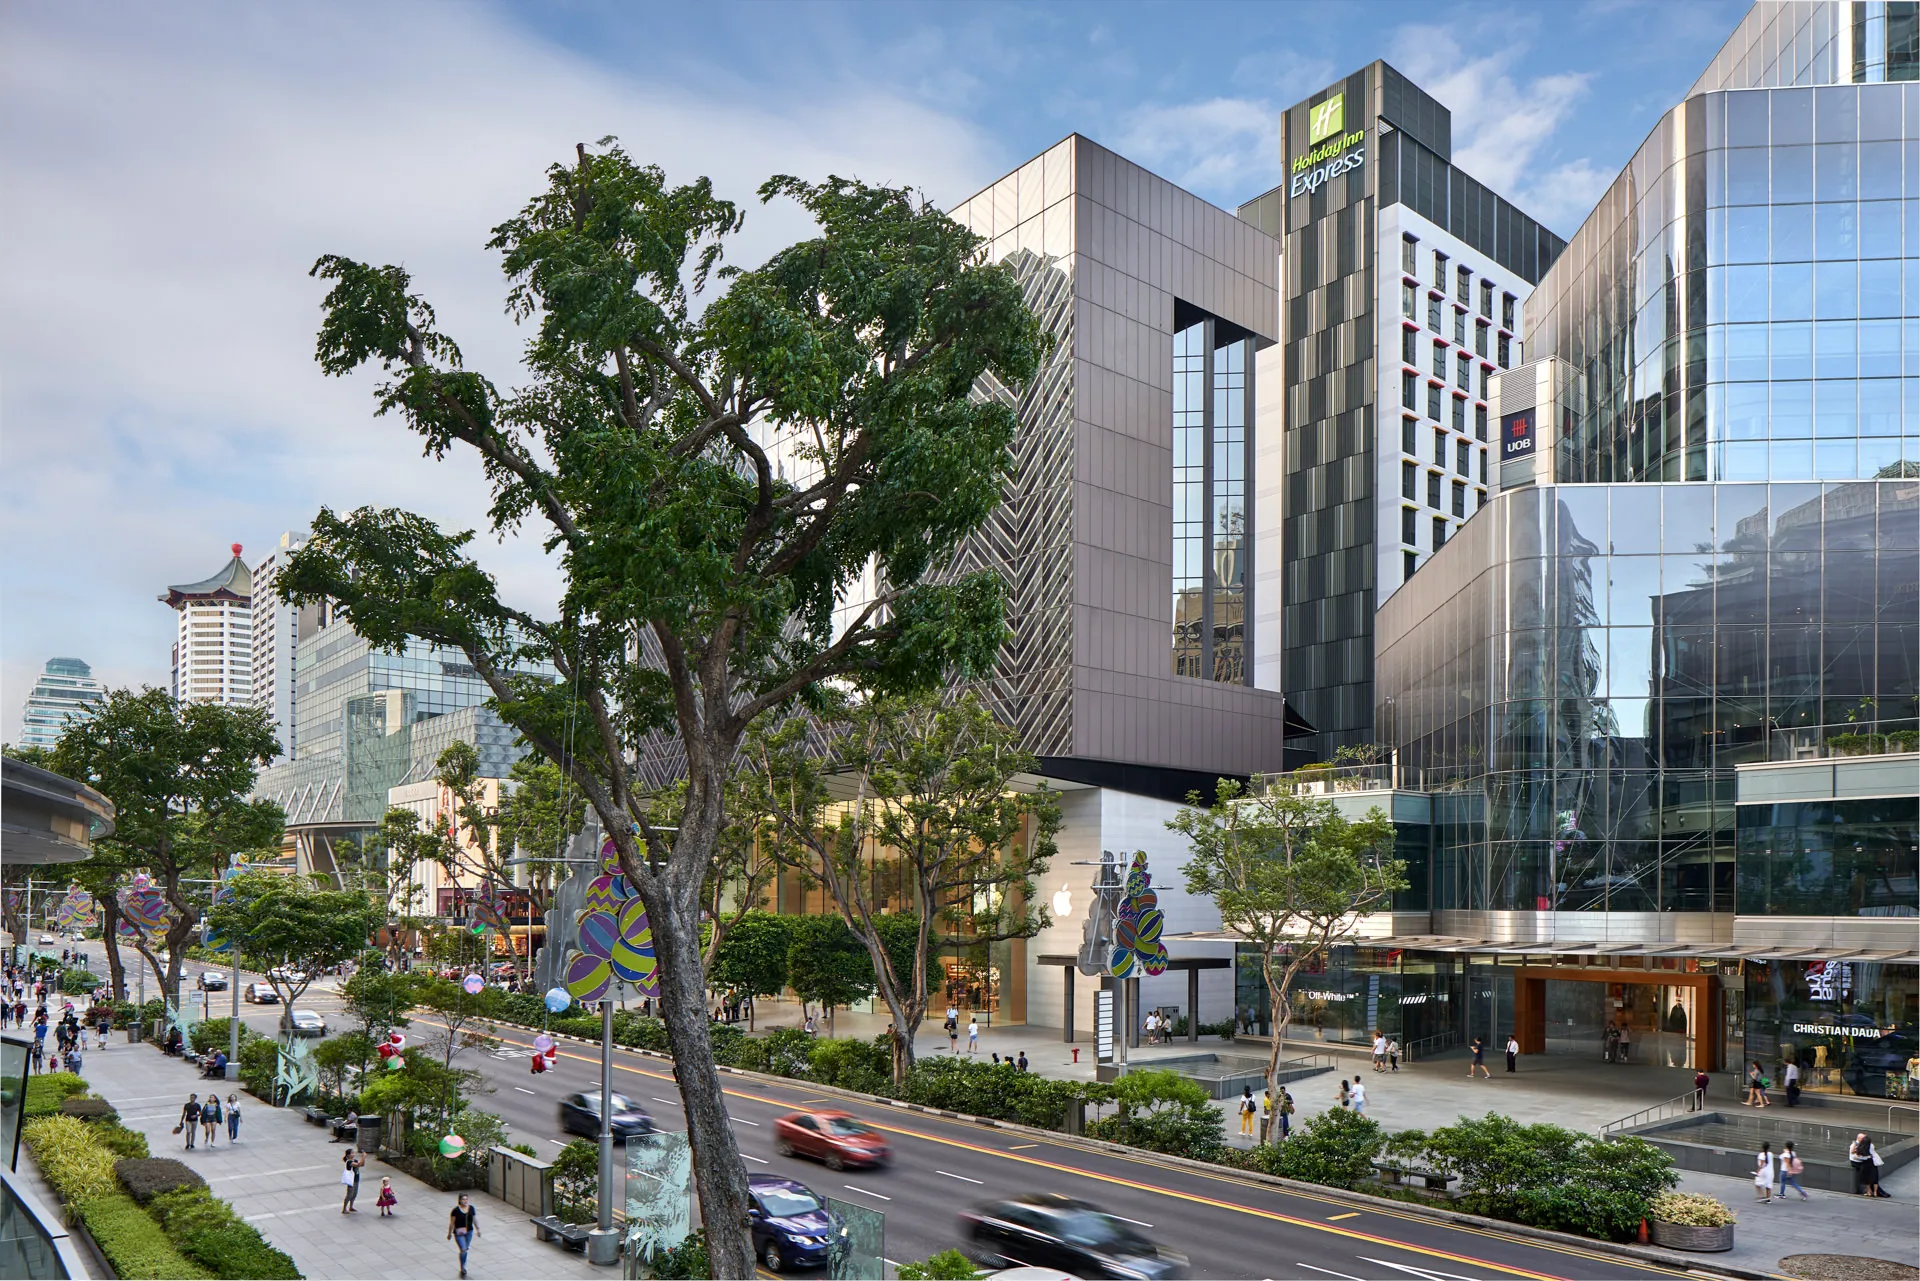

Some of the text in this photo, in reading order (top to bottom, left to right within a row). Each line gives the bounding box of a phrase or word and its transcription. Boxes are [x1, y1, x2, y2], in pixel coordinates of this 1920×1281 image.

[1292, 129, 1364, 174] Holiday Inn
[1290, 148, 1365, 199] Express
[1507, 438, 1532, 453] UOB
[1793, 1023, 1850, 1037] CHRISTIAN
